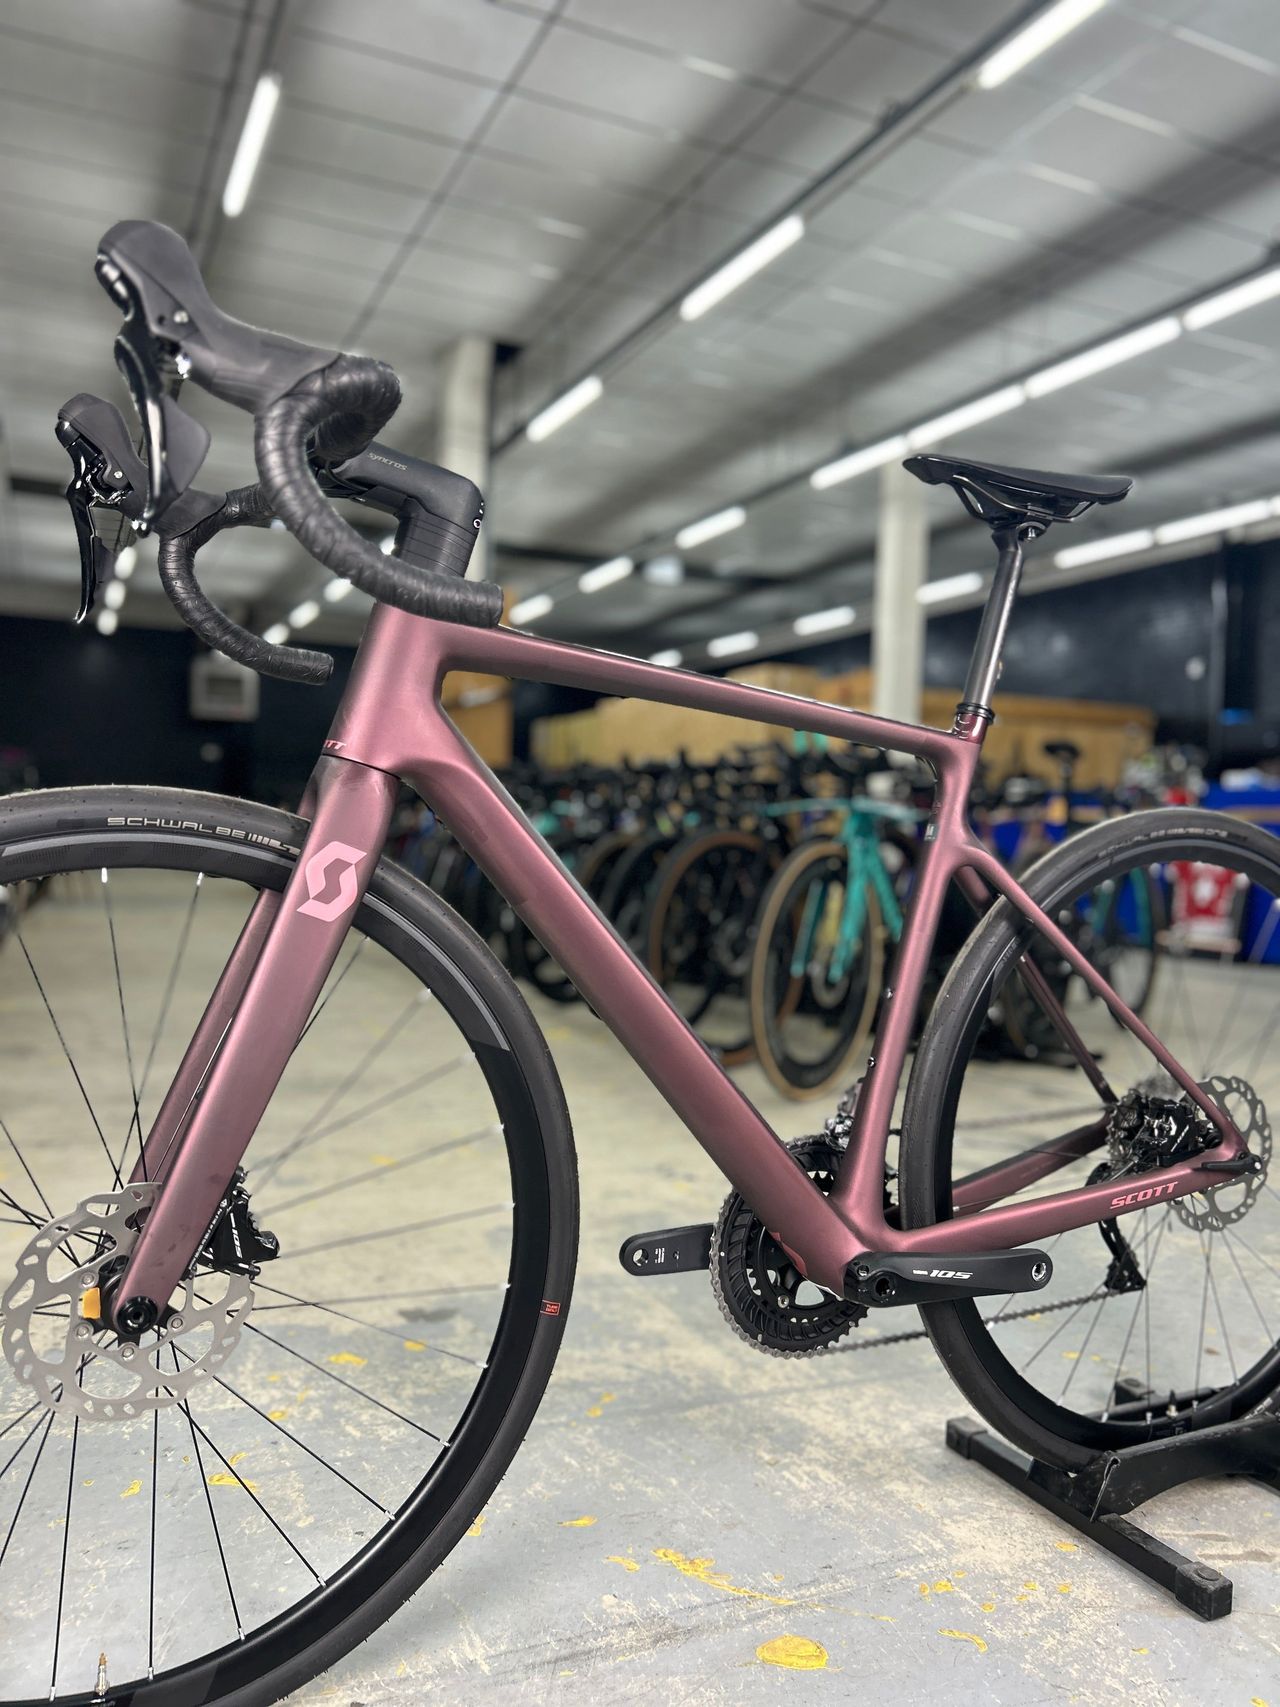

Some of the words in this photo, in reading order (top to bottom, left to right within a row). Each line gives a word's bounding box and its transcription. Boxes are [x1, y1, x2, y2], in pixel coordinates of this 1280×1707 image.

[107, 817, 246, 839] SCHWALBE
[1109, 1181, 1179, 1210] SCOTT
[929, 1269, 974, 1280] 105
